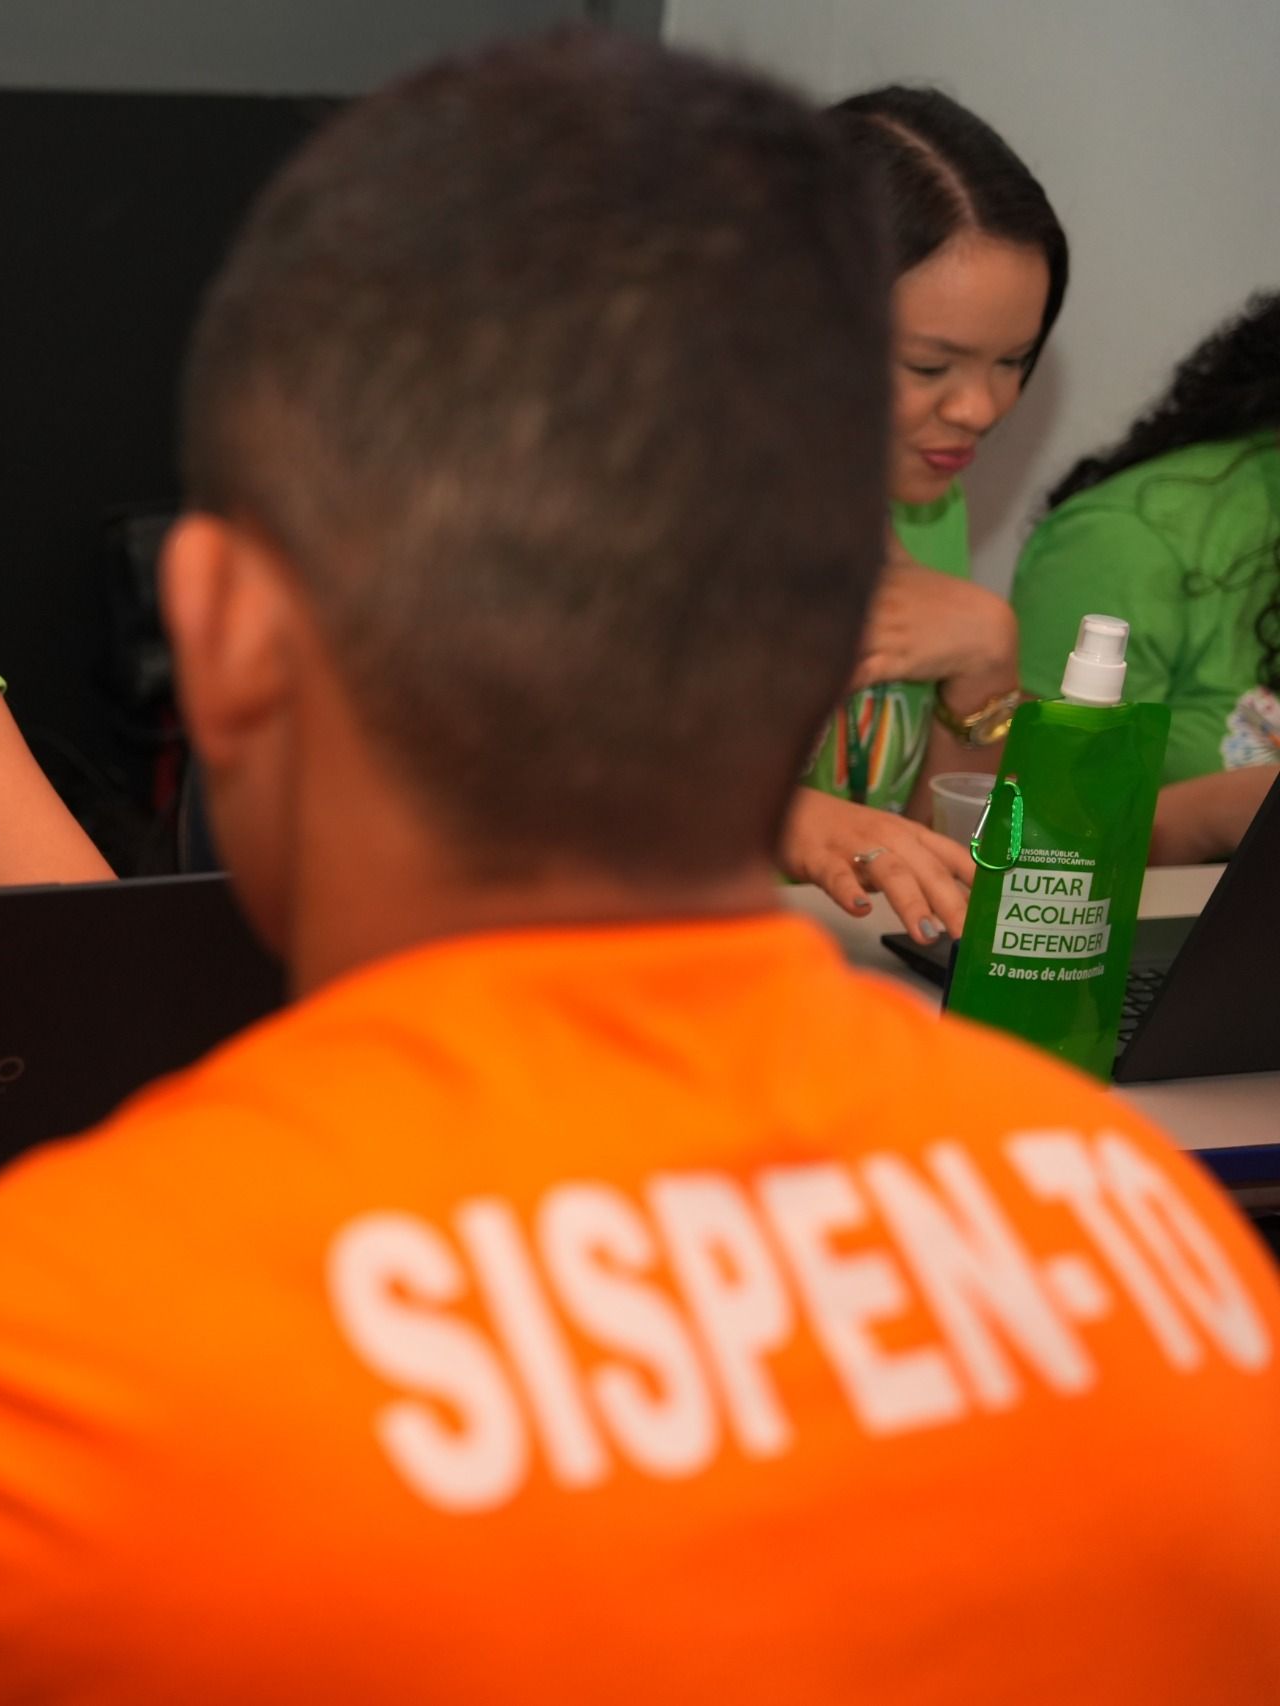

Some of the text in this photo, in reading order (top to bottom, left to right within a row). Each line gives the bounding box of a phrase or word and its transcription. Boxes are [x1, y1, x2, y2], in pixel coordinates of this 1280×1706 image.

[1019, 855, 1046, 864] ESTADO
[1058, 857, 1096, 867] TOCANTINS
[1050, 847, 1079, 858] PÚBLICA
[1010, 873, 1083, 897] LUTAR
[1004, 903, 1104, 926] ACOLHER
[1001, 931, 1103, 954] DEFENDER
[988, 961, 1105, 982] 20 anos de Autonomia
[327, 1128, 1273, 1513] SISPEN-TO
